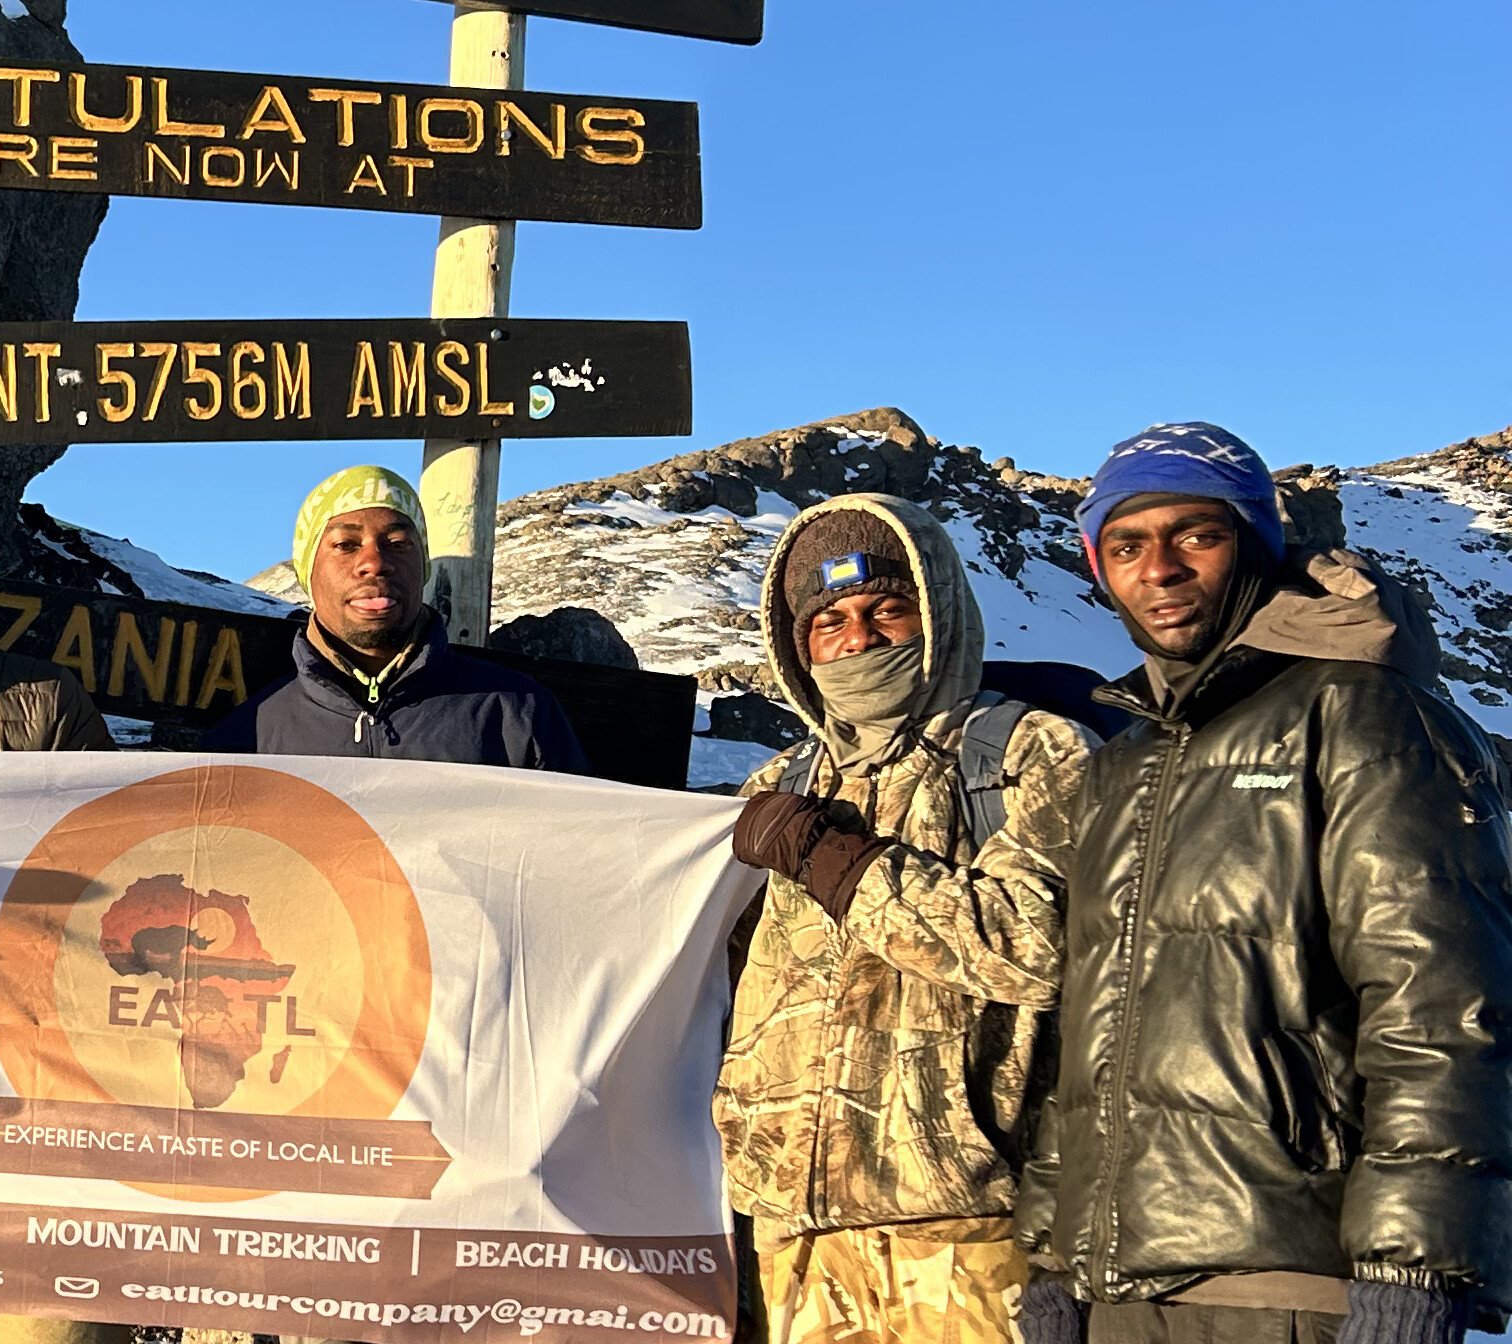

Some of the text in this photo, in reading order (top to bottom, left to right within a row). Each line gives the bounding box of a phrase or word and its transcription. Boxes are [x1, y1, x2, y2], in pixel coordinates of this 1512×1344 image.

[143, 142, 299, 190] NOW
[343, 154, 436, 198] AT
[96, 341, 312, 424] 5756M
[346, 341, 515, 419] AMSL
[4, 1124, 393, 1167] EXPERIENCE A TASTE OF LOCAL LIFE
[26, 1216, 200, 1254] MOUNTAIN
[212, 1228, 381, 1264] TREKKING
[455, 1240, 569, 1268] BEACH
[578, 1245, 718, 1275] HOLIDAYS
